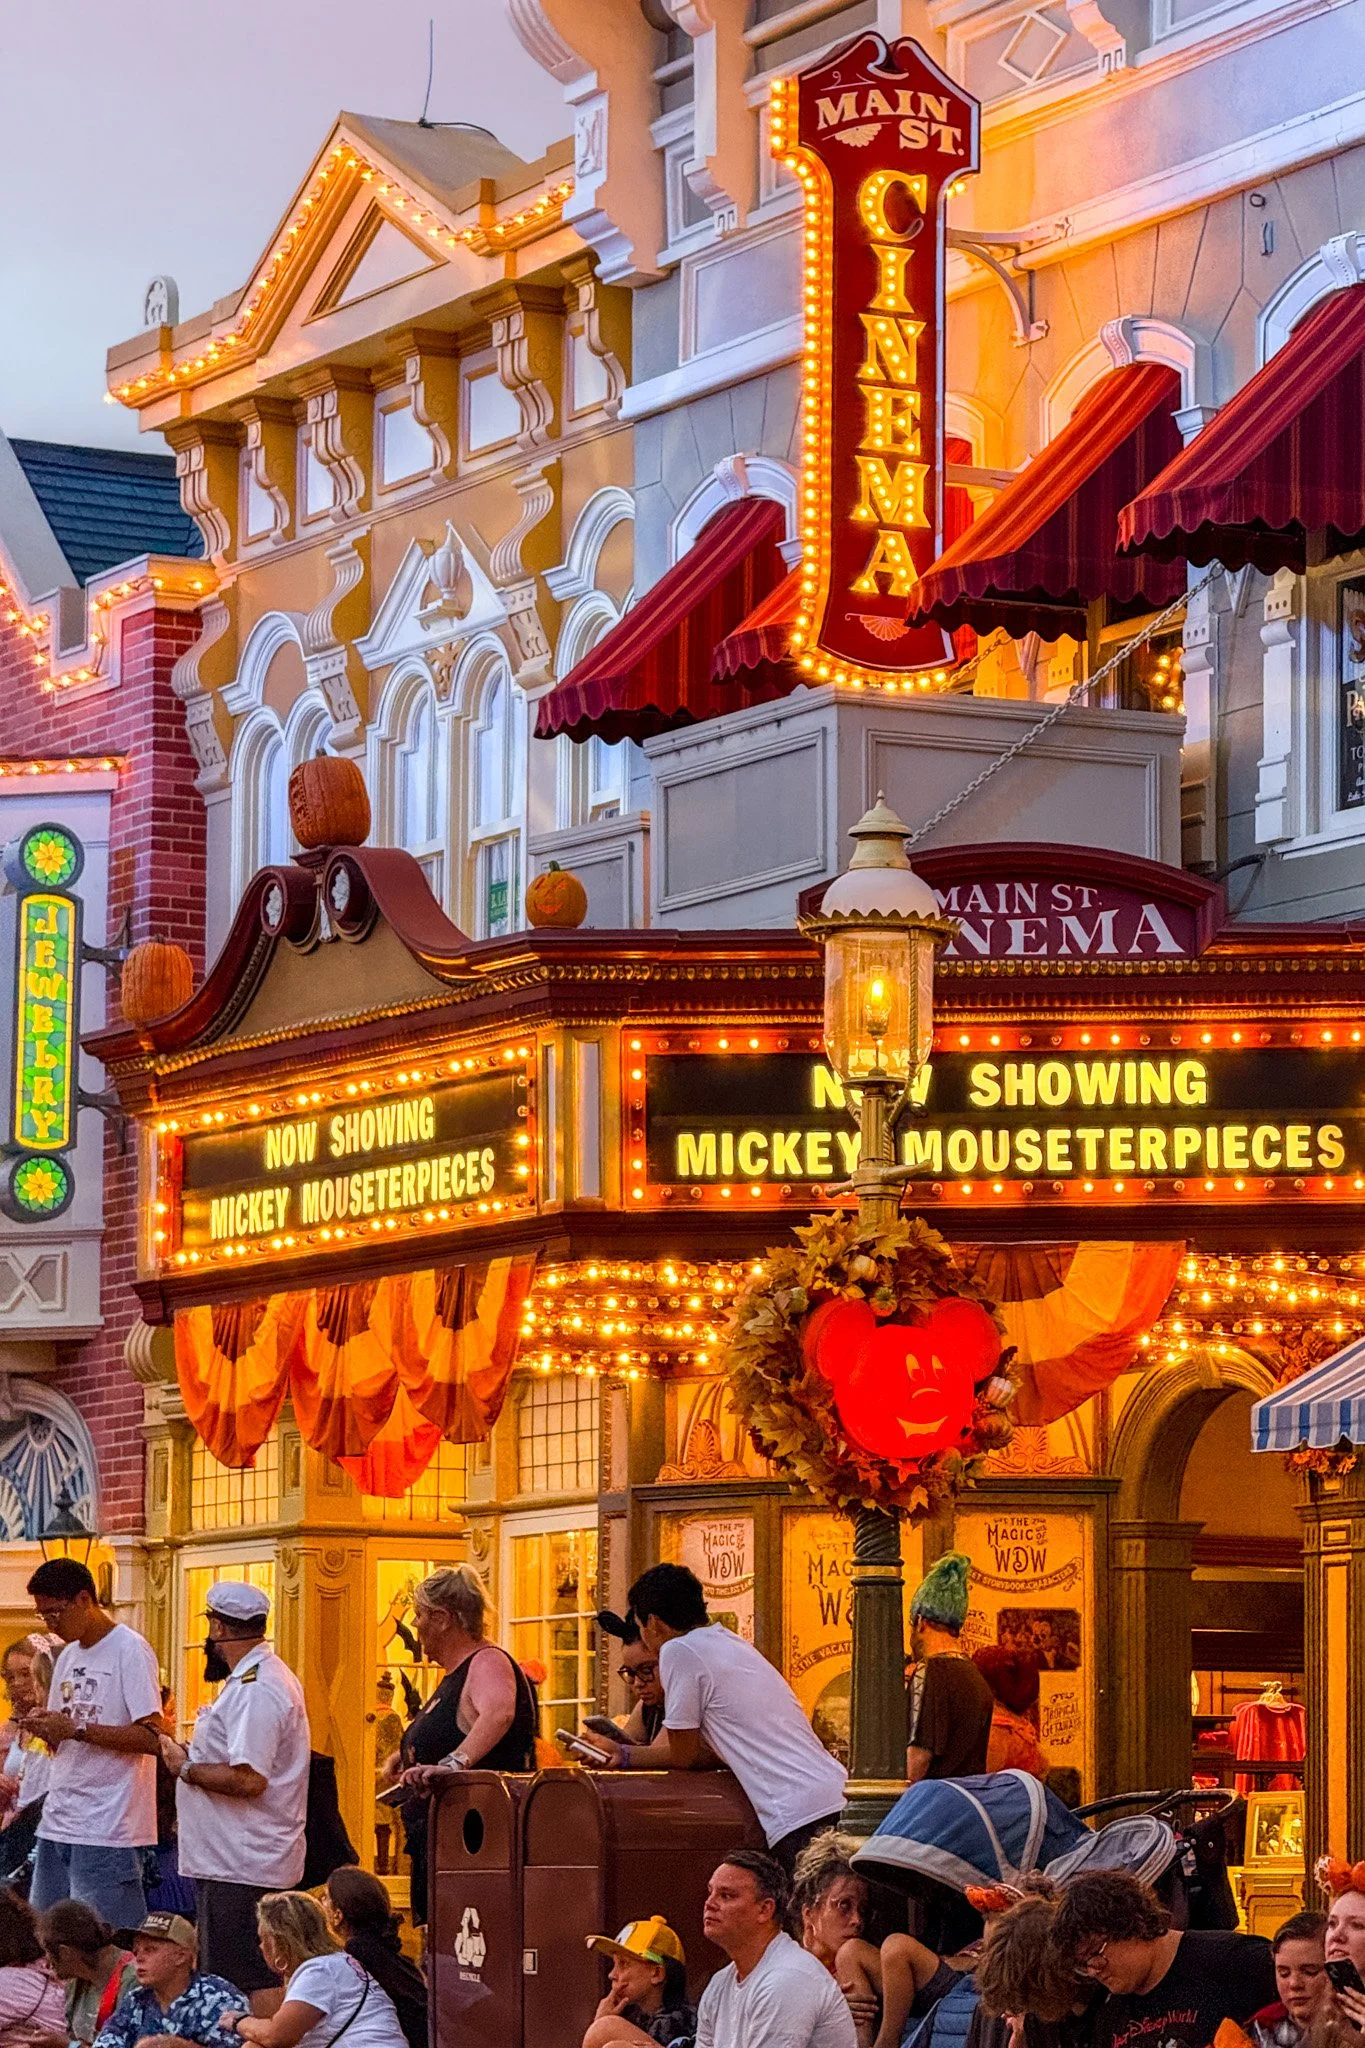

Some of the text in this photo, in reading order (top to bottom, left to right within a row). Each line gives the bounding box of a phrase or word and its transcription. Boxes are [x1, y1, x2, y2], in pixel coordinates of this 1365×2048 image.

[814, 89, 951, 131] MAIN
[899, 118, 965, 156] ST.
[849, 168, 931, 598] CINEMA
[932, 883, 1103, 914] MAIN ST.
[944, 903, 1186, 956] NEMA
[26, 905, 64, 1139] JEWELRY
[969, 1060, 1209, 1107] SHOWING
[264, 1096, 435, 1170] NOW SHOWING
[678, 1124, 1345, 1176] MICKEY MOUSETERPIECES
[210, 1147, 496, 1240] MICKEY MOUSETERPIECES
[984, 1522, 1034, 1546] MAGIC
[1010, 1517, 1029, 1526] THE
[701, 1530, 735, 1555] MAGIC
[990, 1545, 1047, 1574] WDW
[707, 1551, 745, 1579] WDW
[799, 1653, 816, 1670] THE
